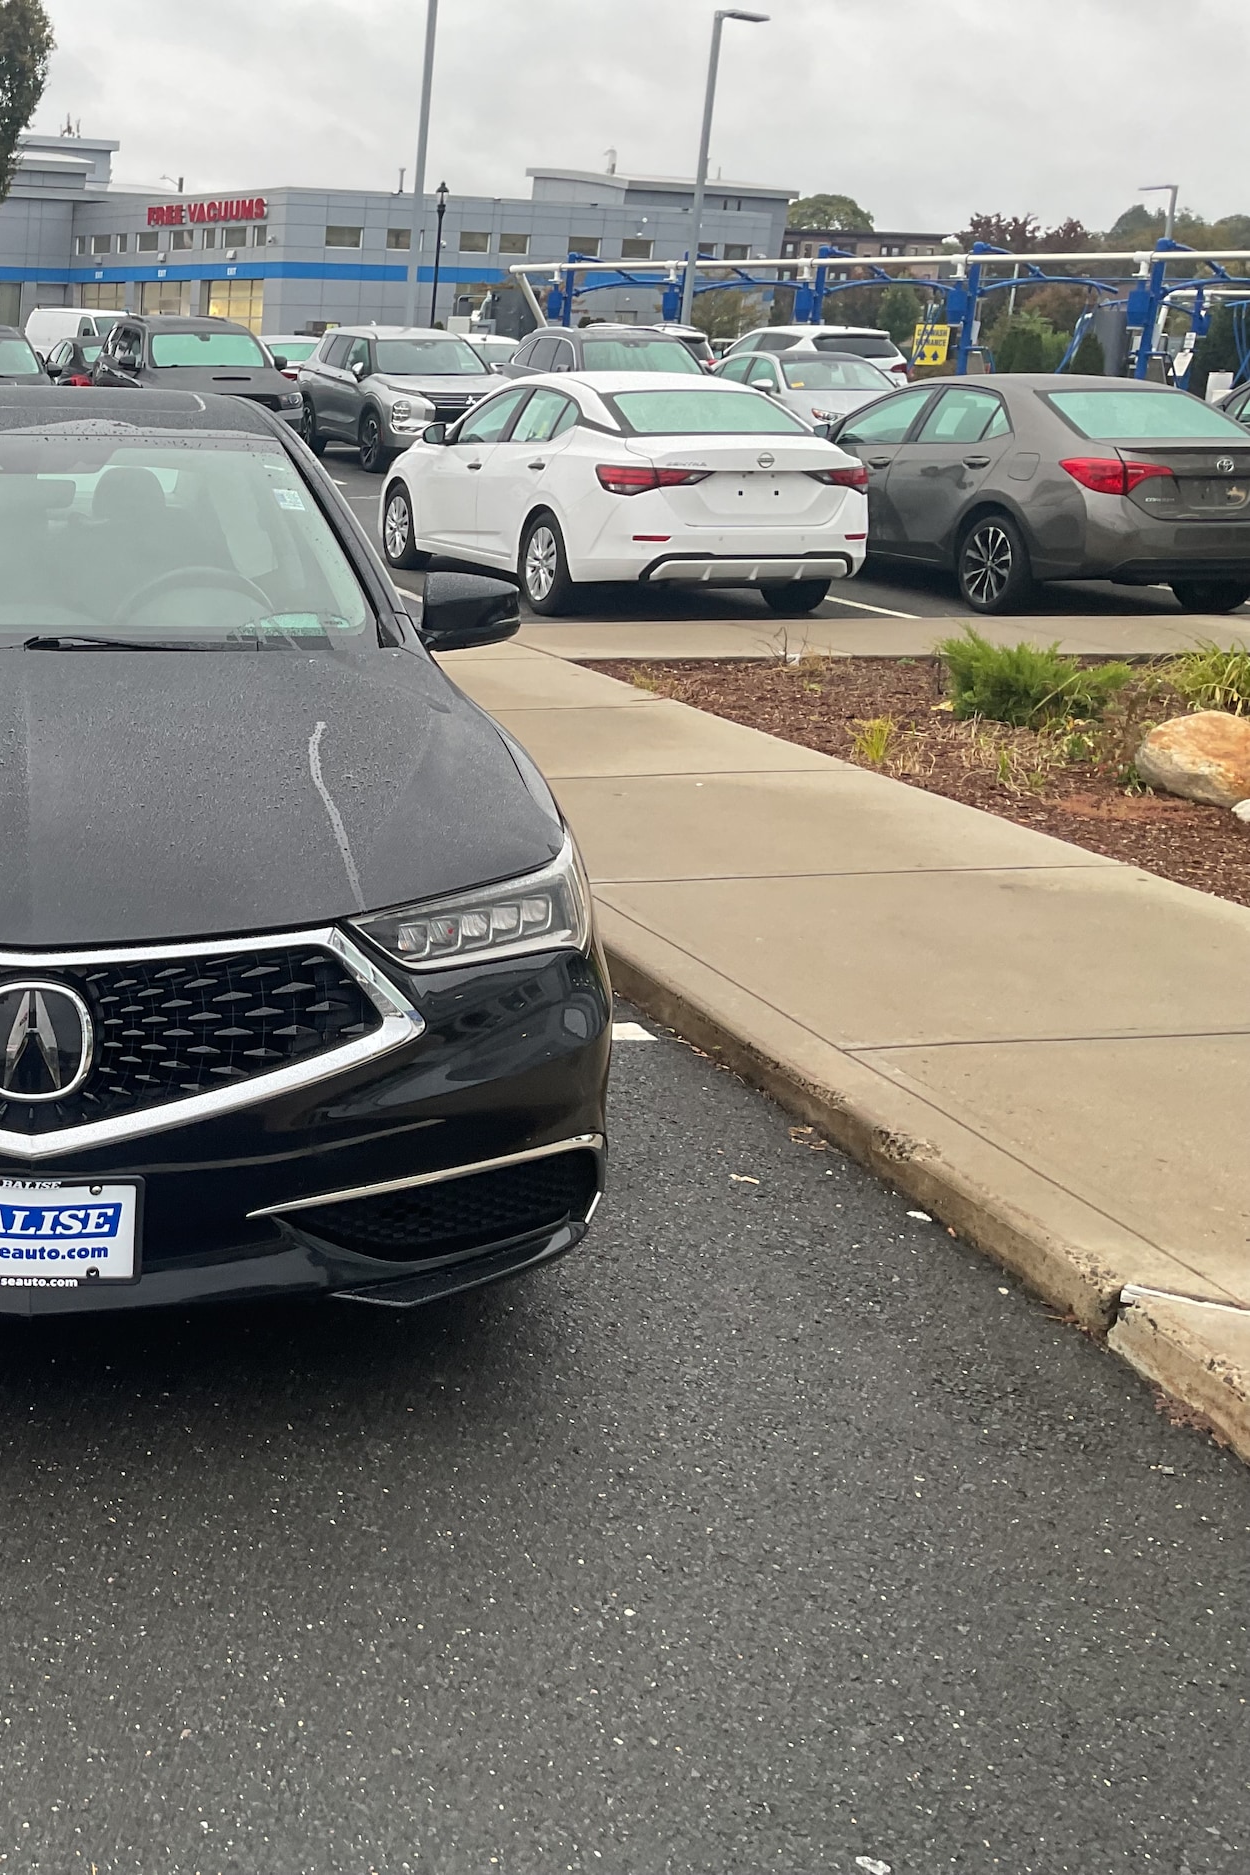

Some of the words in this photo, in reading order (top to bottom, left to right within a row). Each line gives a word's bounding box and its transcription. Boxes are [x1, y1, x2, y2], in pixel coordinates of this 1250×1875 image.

[147, 204, 187, 226] FREE
[187, 197, 269, 223] VACUUMS
[1, 1179, 62, 1191] BALISE
